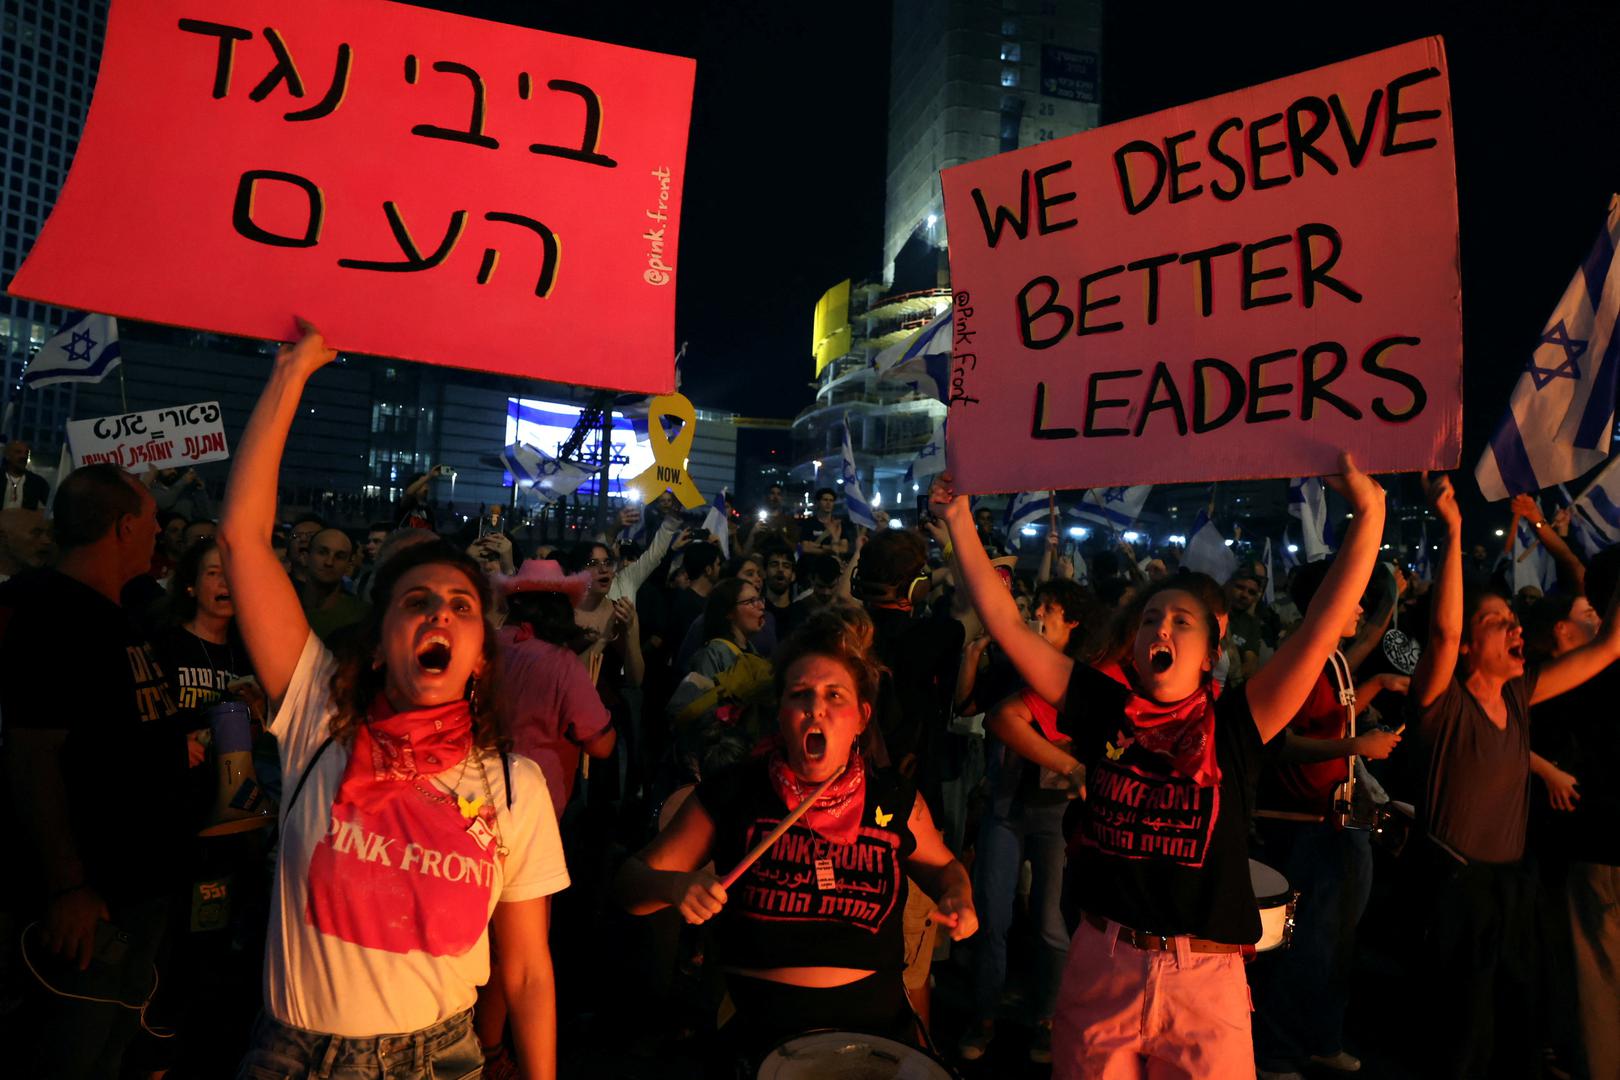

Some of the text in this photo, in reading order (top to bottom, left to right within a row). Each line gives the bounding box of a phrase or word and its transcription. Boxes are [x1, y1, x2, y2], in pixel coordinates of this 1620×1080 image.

[177, 17, 618, 168] ביבי נגד
[971, 66, 1442, 249] WE DESERVE
[232, 169, 561, 299] העם
[643, 165, 673, 286] @pink.front
[1016, 222, 1363, 351] BETTER
[93, 404, 220, 440] פיטורי גלנט
[1030, 335, 1428, 440] LEADERS
[182, 432, 225, 460] מתנת
[656, 464, 682, 485] NOW.
[178, 667, 213, 688] שנה
[1090, 767, 1201, 811] PINKFRONT
[319, 817, 494, 888] PINK FRONT
[818, 894, 882, 921] החזית
